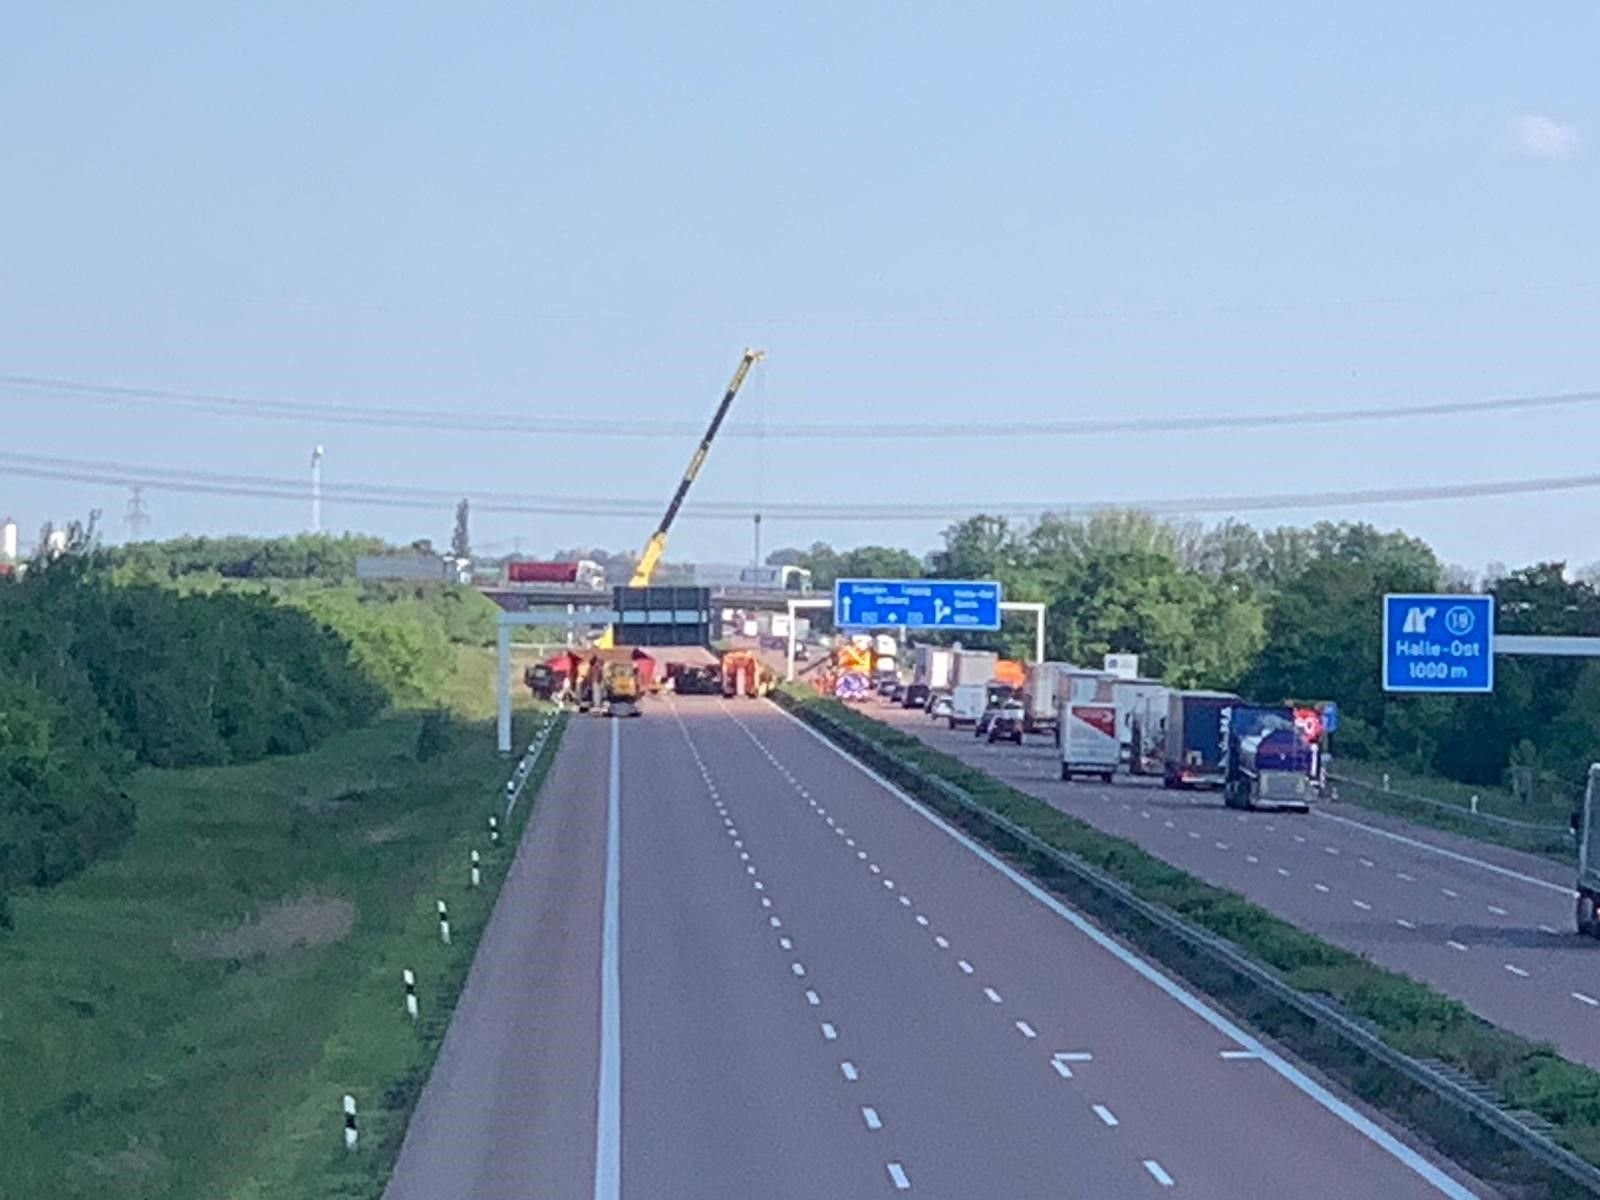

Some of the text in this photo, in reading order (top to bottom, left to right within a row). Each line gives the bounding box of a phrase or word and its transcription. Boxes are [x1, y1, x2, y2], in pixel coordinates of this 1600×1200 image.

[1396, 640, 1480, 656] Halle-Ost
[1409, 662, 1468, 678] 1000 m
